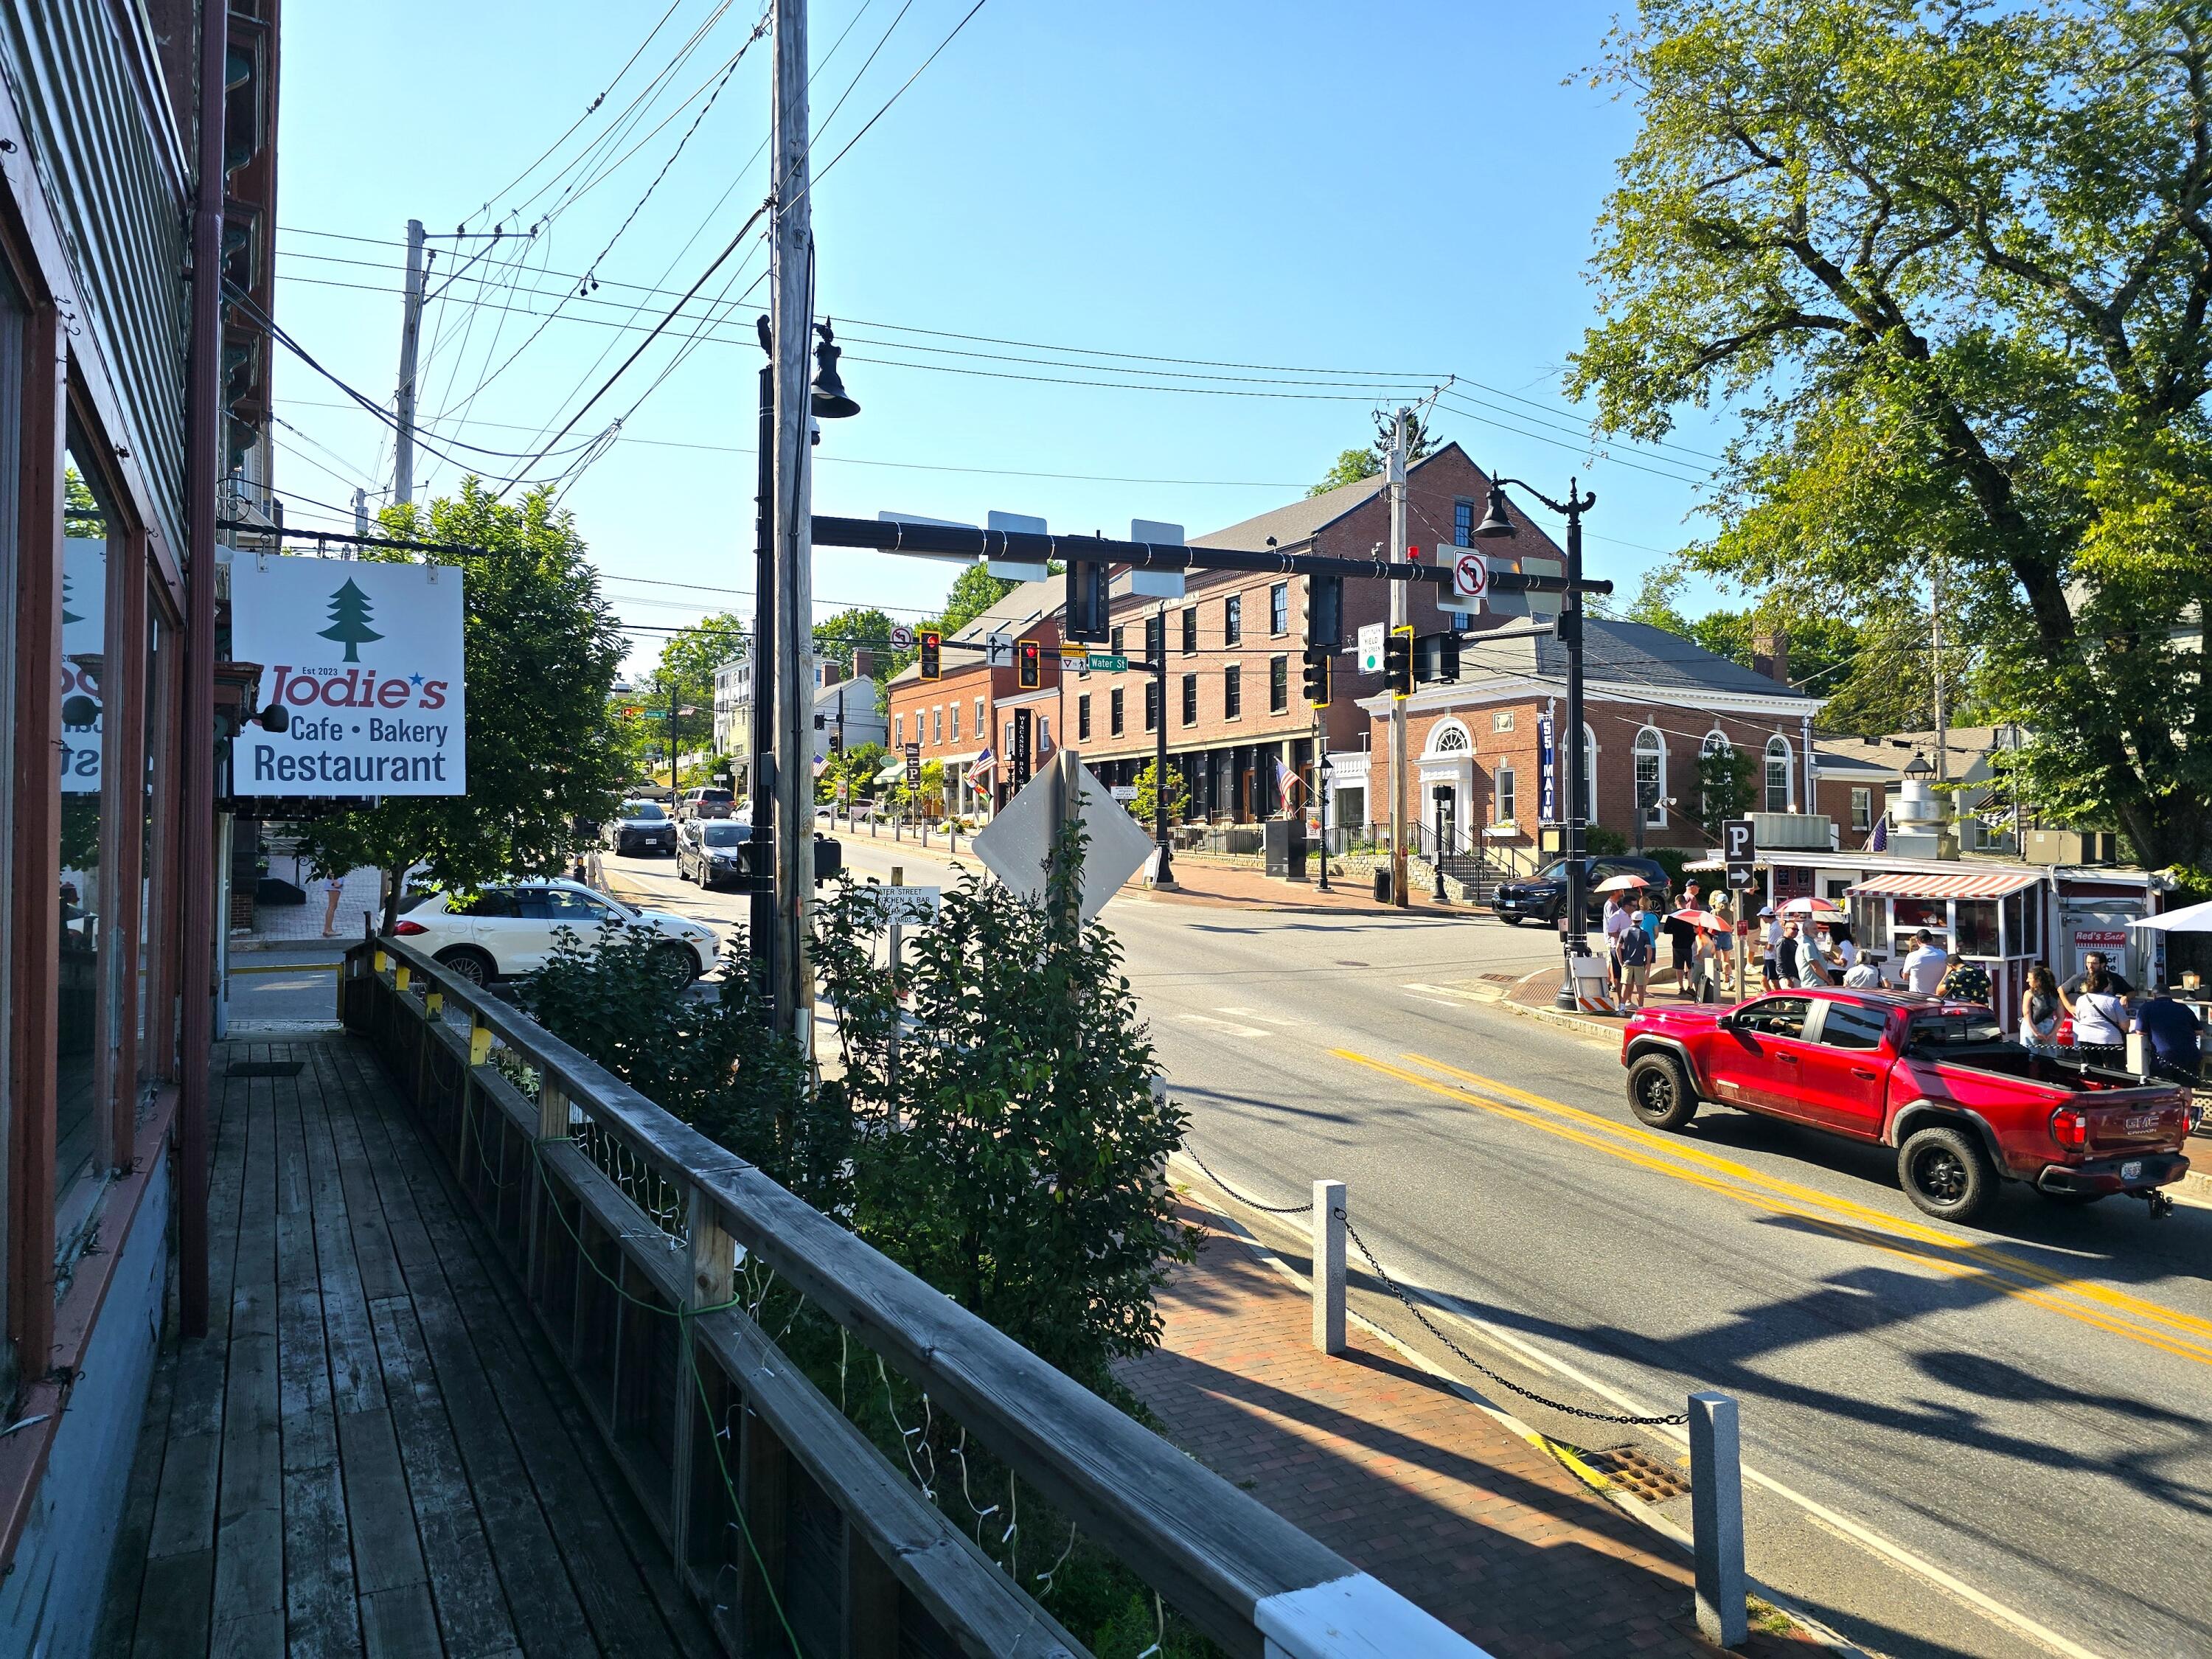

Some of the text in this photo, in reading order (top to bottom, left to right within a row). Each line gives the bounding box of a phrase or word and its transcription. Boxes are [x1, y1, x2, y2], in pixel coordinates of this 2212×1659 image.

[1364, 636, 1378, 645] YIELD
[1091, 658, 1124, 669] Water St
[302, 667, 338, 675] Est 2023
[291, 715, 448, 747] Cafe Bakery
[254, 745, 446, 782] Restaurant
[909, 768, 918, 779] P
[1543, 722, 1554, 818] 55 MAIN
[1729, 827, 1749, 856] P
[2076, 931, 2125, 941] Red's Eats
[2126, 1116, 2160, 1129] GMC
